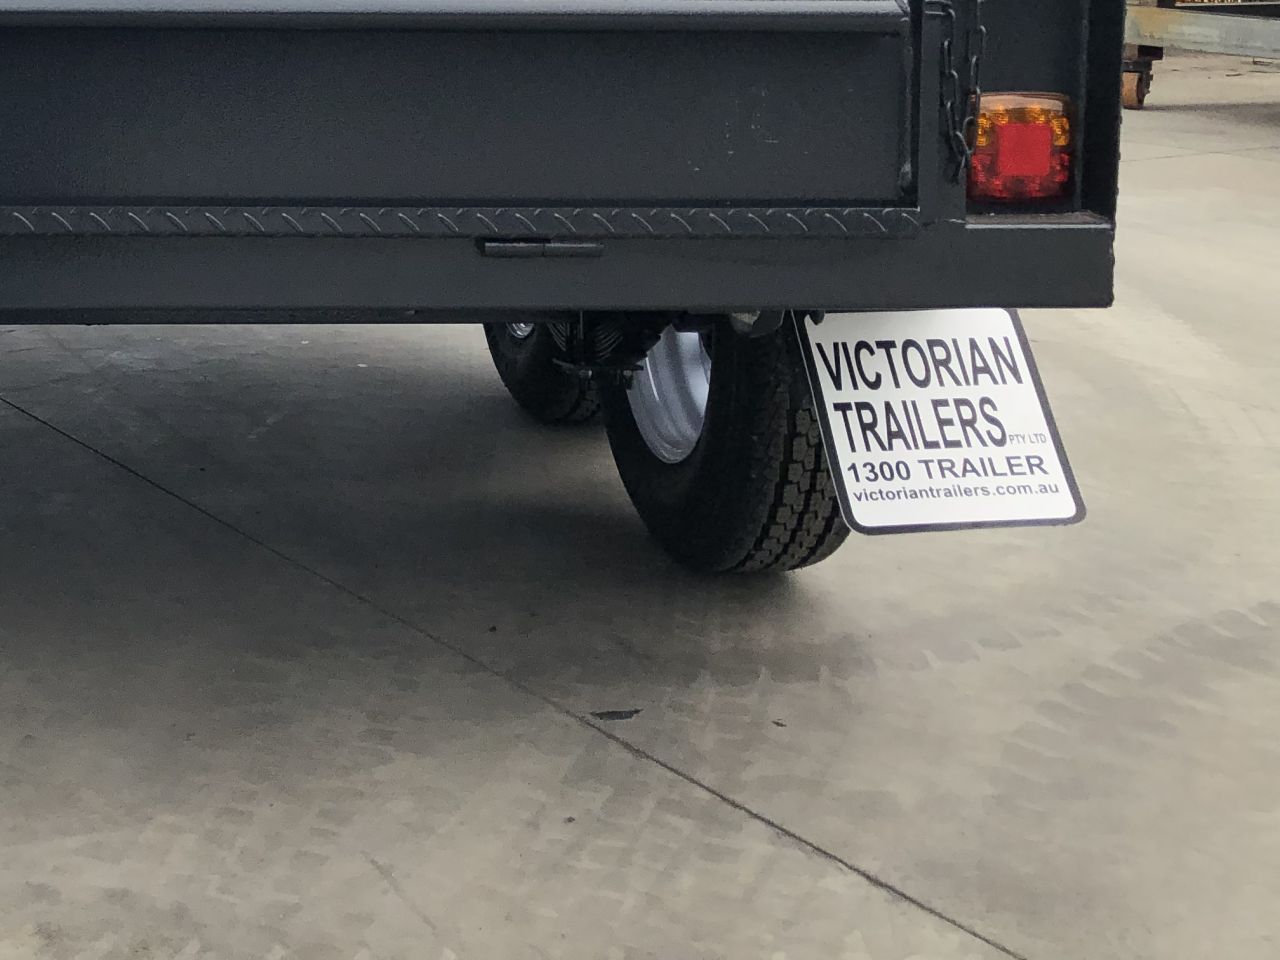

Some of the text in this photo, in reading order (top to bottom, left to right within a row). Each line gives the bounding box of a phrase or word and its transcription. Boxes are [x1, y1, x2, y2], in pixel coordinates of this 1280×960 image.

[815, 336, 1023, 391] VICTORIAN
[833, 396, 1047, 453] TRAILERS PTY LTD
[847, 454, 1050, 483] 1300 TRAILER
[853, 482, 1060, 503] victoriantrailers.com.au
